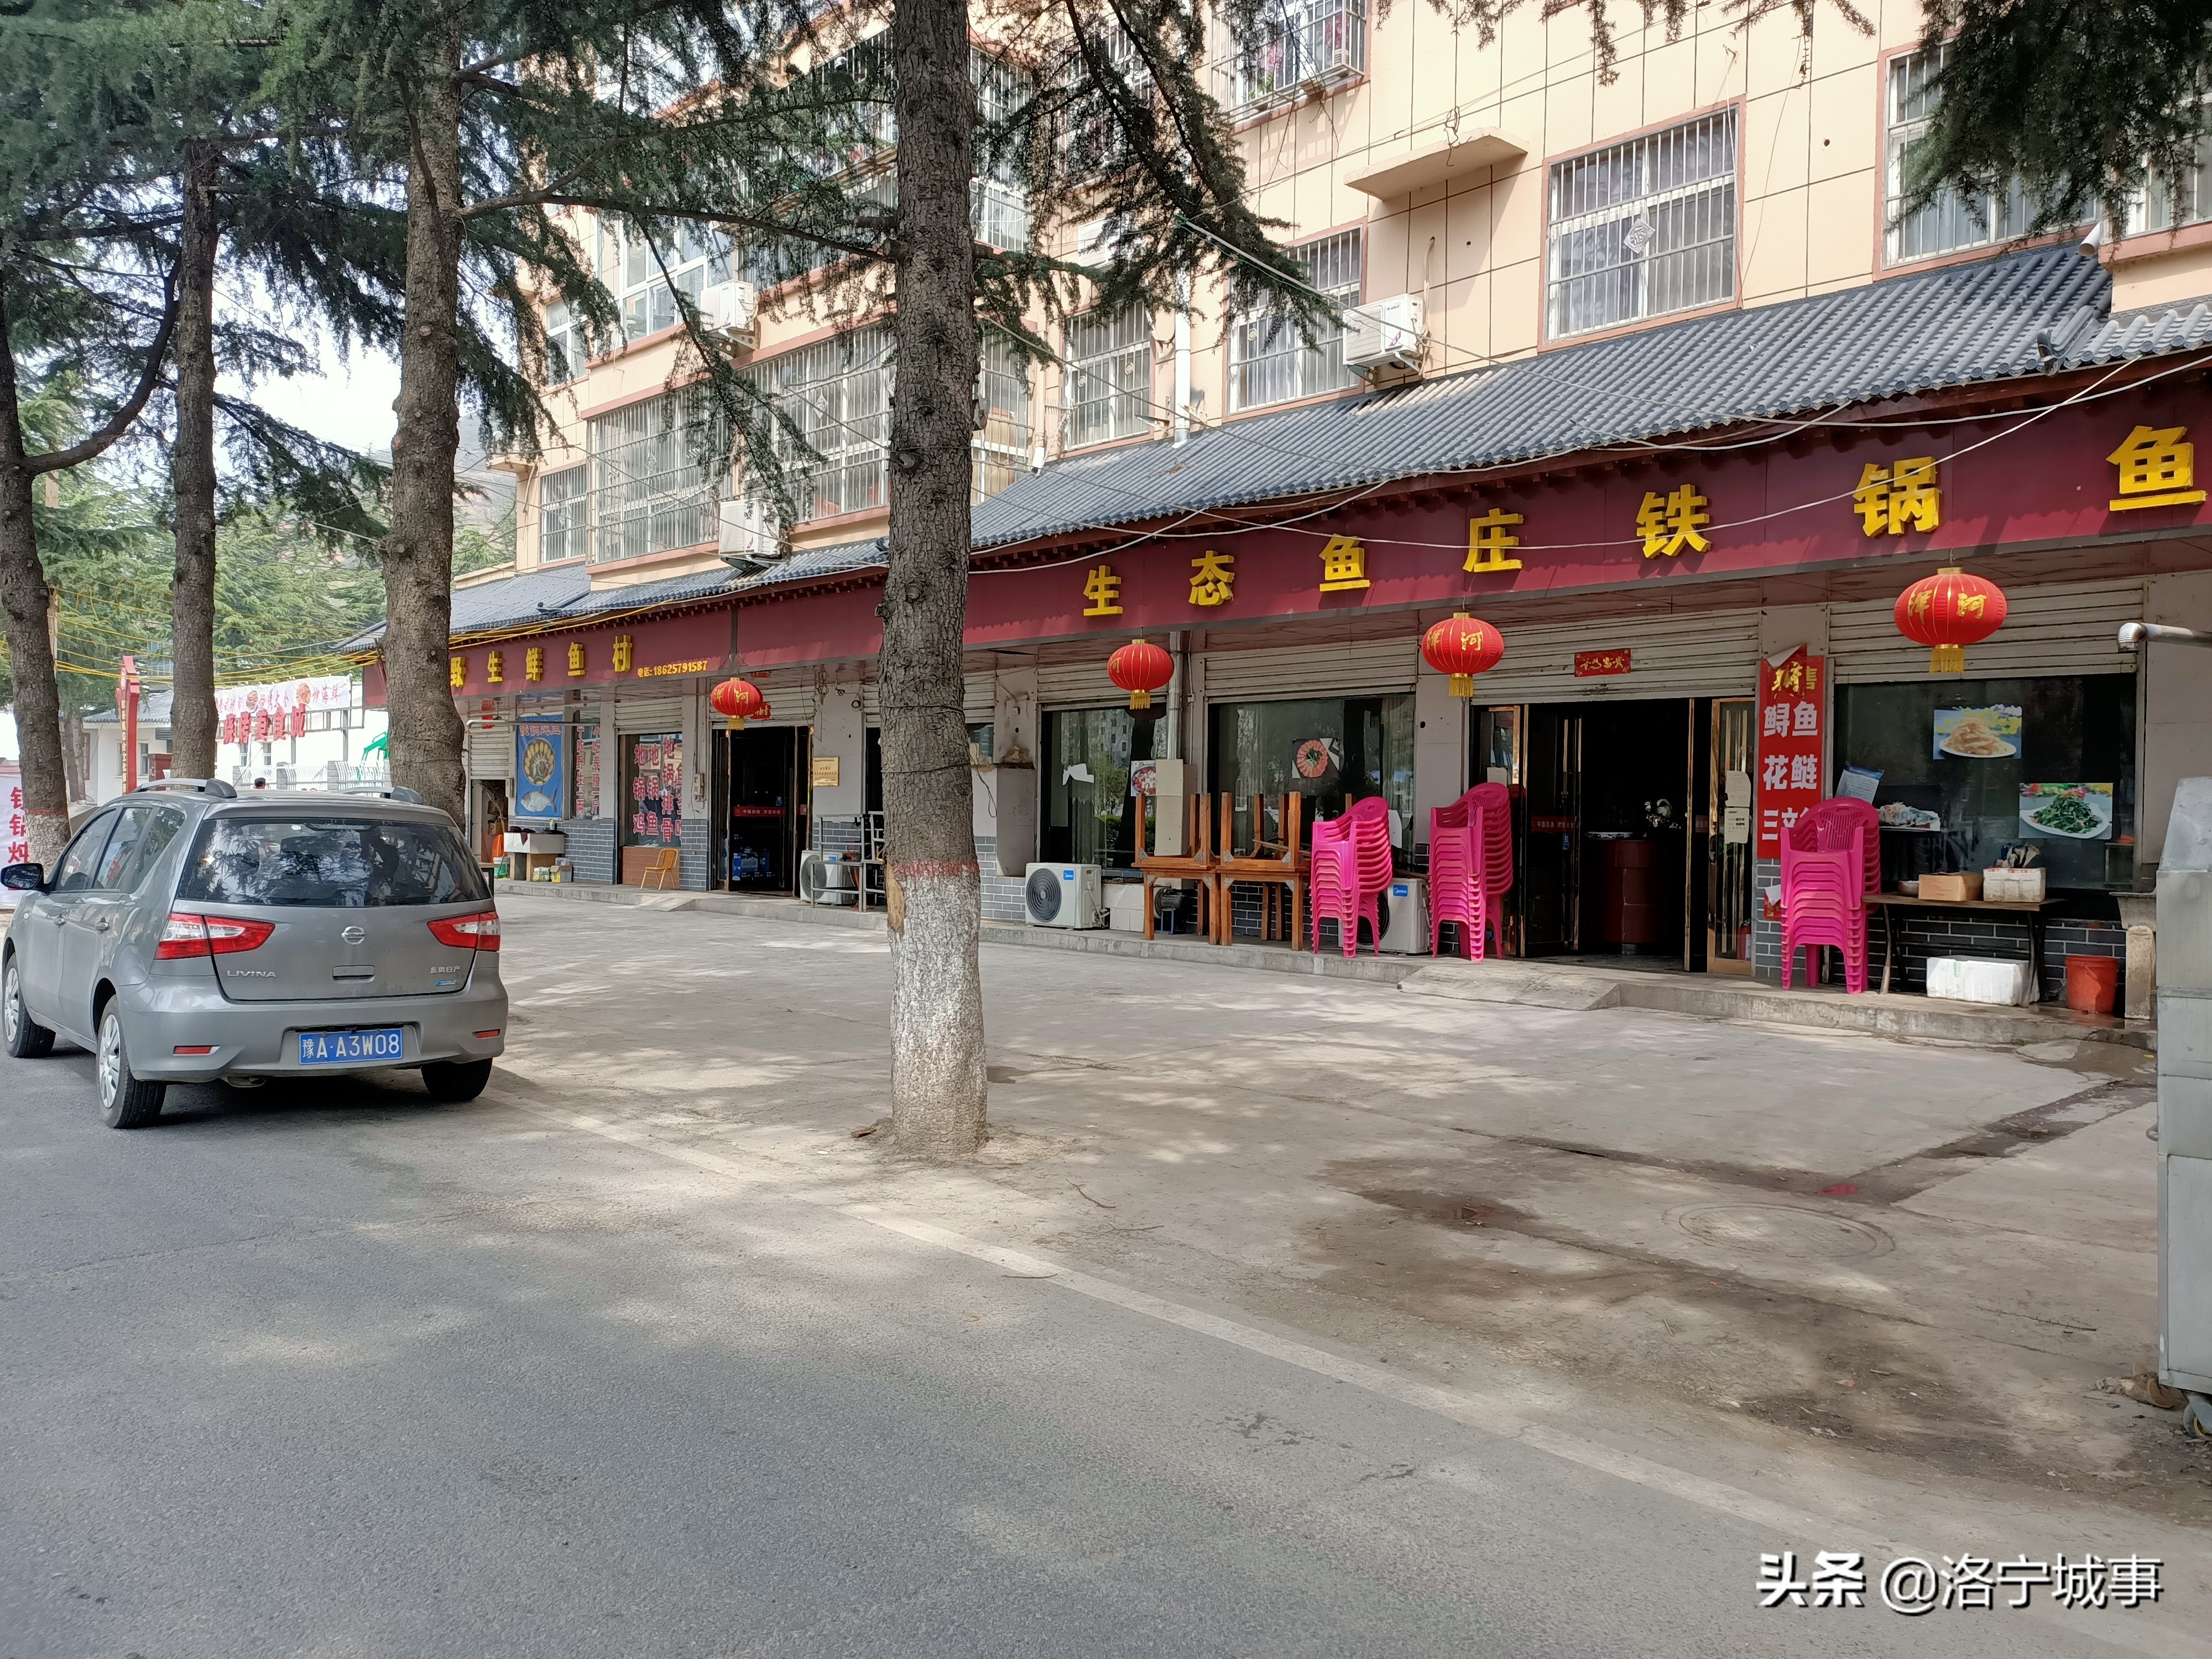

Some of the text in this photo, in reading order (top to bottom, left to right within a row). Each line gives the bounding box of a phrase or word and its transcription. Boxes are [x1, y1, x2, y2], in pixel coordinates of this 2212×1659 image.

[1764, 701, 1818, 738] 鲟鱼
[633, 743, 646, 836] 地锅鸡
[646, 743, 660, 836] 地锅鱼
[661, 738, 675, 842] 地锅排骨
[1762, 754, 1818, 791] 花鲢
[1762, 807, 1809, 841] 三文
